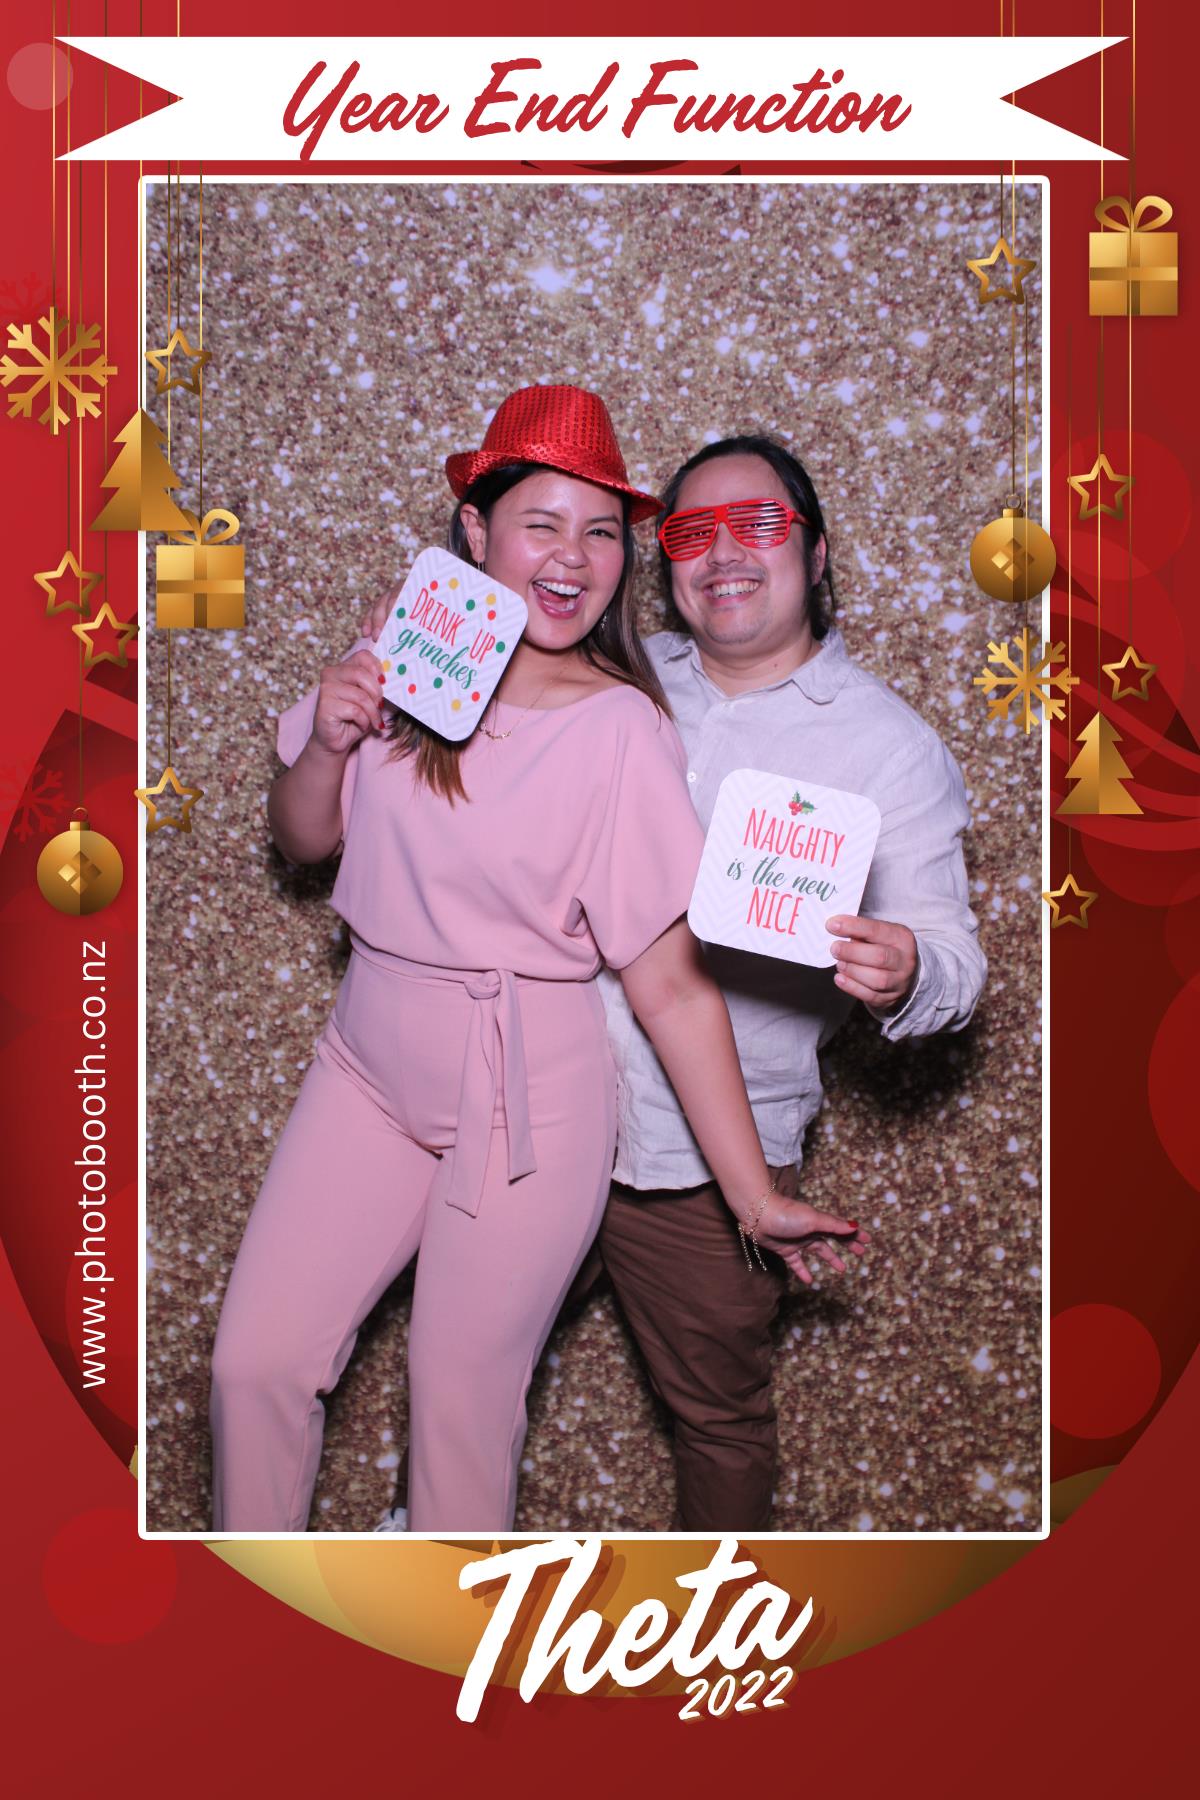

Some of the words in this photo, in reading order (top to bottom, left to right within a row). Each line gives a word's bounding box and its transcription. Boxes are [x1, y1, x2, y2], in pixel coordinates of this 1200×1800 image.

[409, 588, 465, 646] DRINK
[470, 628, 496, 664] UP
[389, 628, 477, 690] grinches
[743, 807, 845, 867] NAUGHTY
[726, 857, 748, 881] is
[752, 856, 785, 888] the
[793, 875, 838, 901] new
[746, 886, 804, 936] NICE
